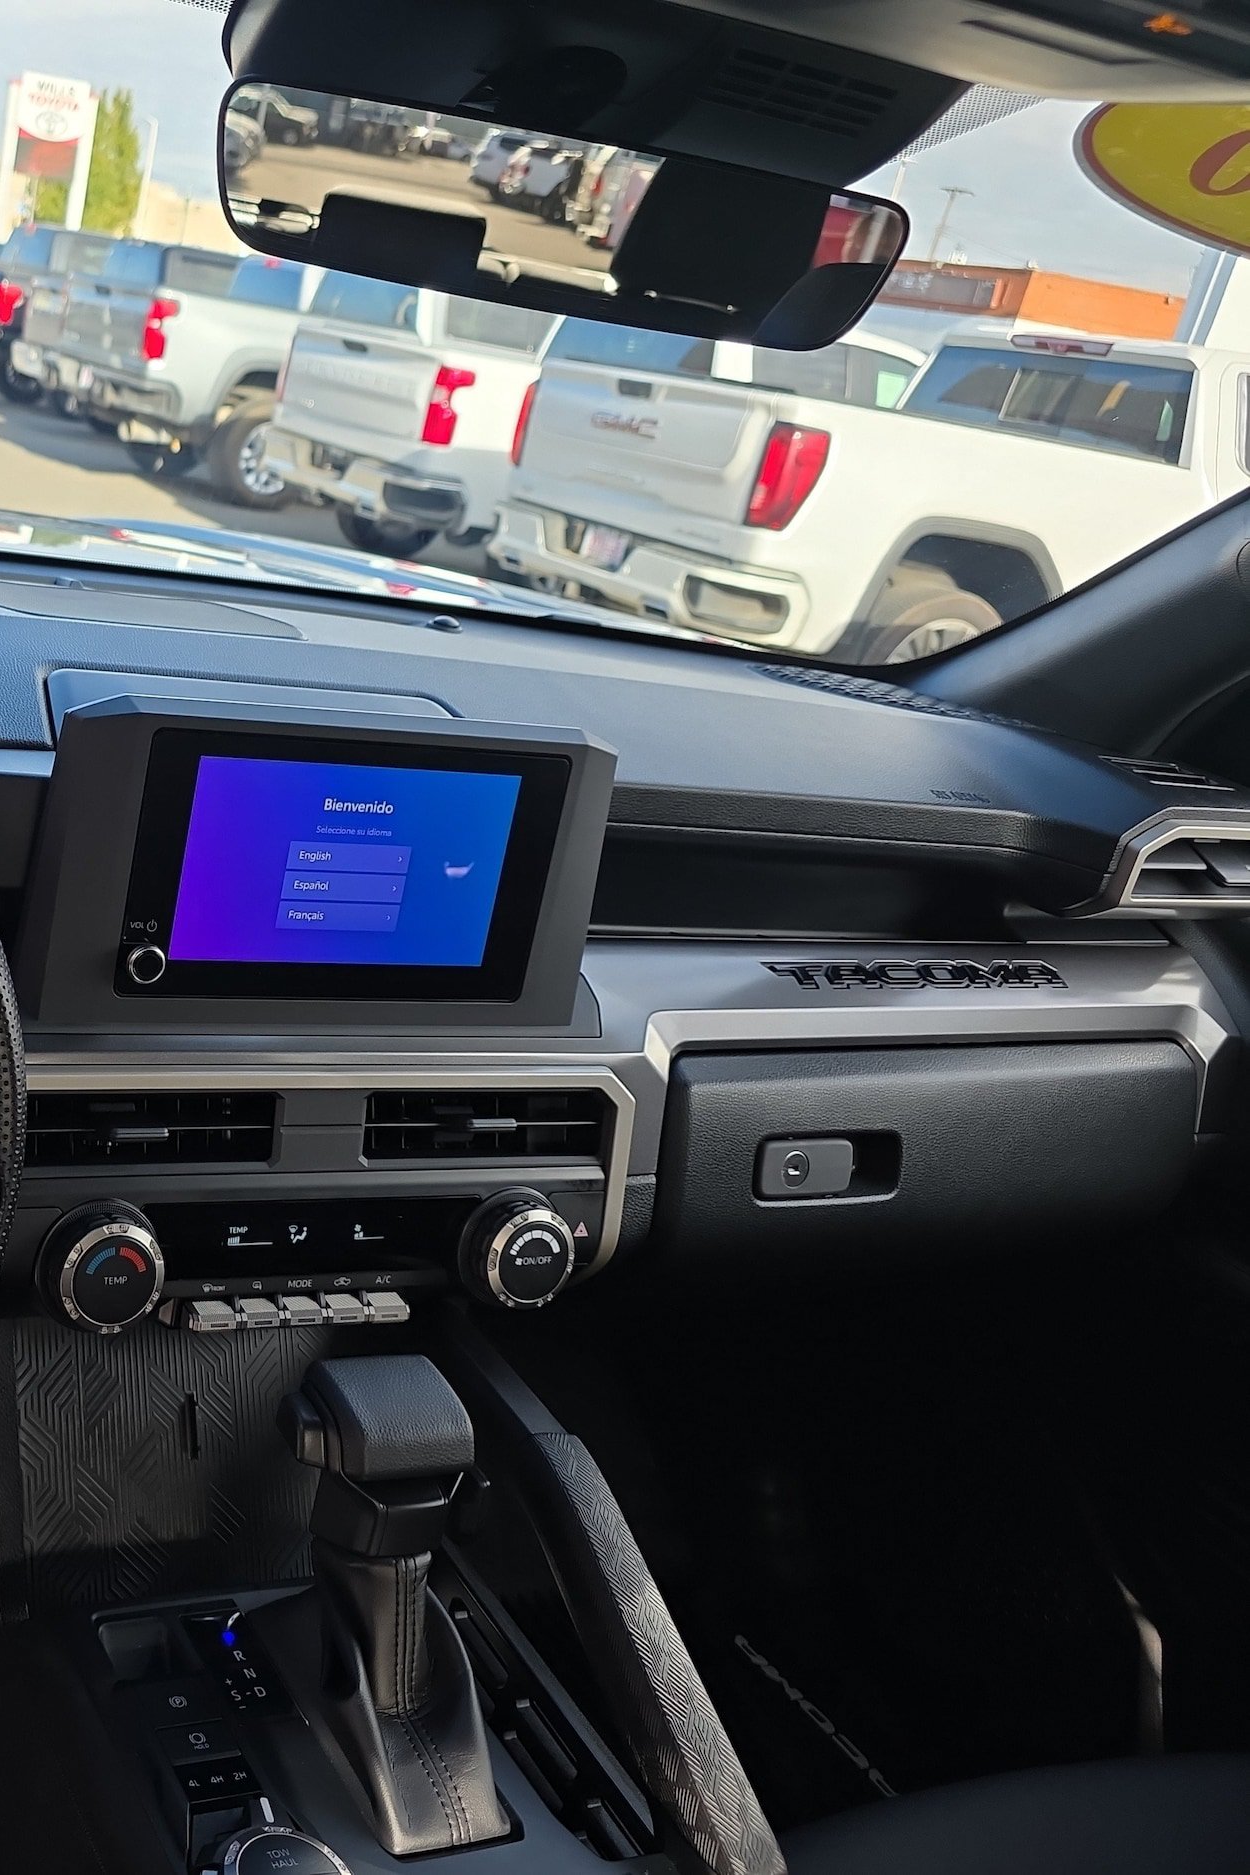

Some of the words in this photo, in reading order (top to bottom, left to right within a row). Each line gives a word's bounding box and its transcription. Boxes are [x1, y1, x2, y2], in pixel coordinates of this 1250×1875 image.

[323, 798, 394, 815] Bienvenido
[316, 825, 356, 836] Seleccione
[356, 828, 366, 836] su
[367, 827, 392, 837] idioma
[299, 850, 332, 863] English
[293, 879, 329, 892] Español
[287, 910, 325, 923] Français
[130, 921, 144, 929] VOL
[759, 959, 1070, 990] TACOMA
[229, 1226, 248, 1235] TEMP
[522, 1256, 553, 1266] ON/OFF
[103, 1275, 128, 1286] TEMP
[287, 1278, 313, 1289] MODE
[375, 1275, 392, 1285] A/C
[211, 1284, 226, 1292] FRONT
[233, 1650, 247, 1662] R
[243, 1667, 257, 1679] N
[230, 1689, 242, 1701] S
[254, 1686, 267, 1698] D
[193, 1742, 210, 1750] HOLD
[188, 1779, 201, 1787] 4L
[210, 1775, 225, 1784] 4H
[233, 1771, 248, 1780] 2H
[266, 1848, 291, 1859] TOW
[271, 1858, 299, 1869] HAUL
